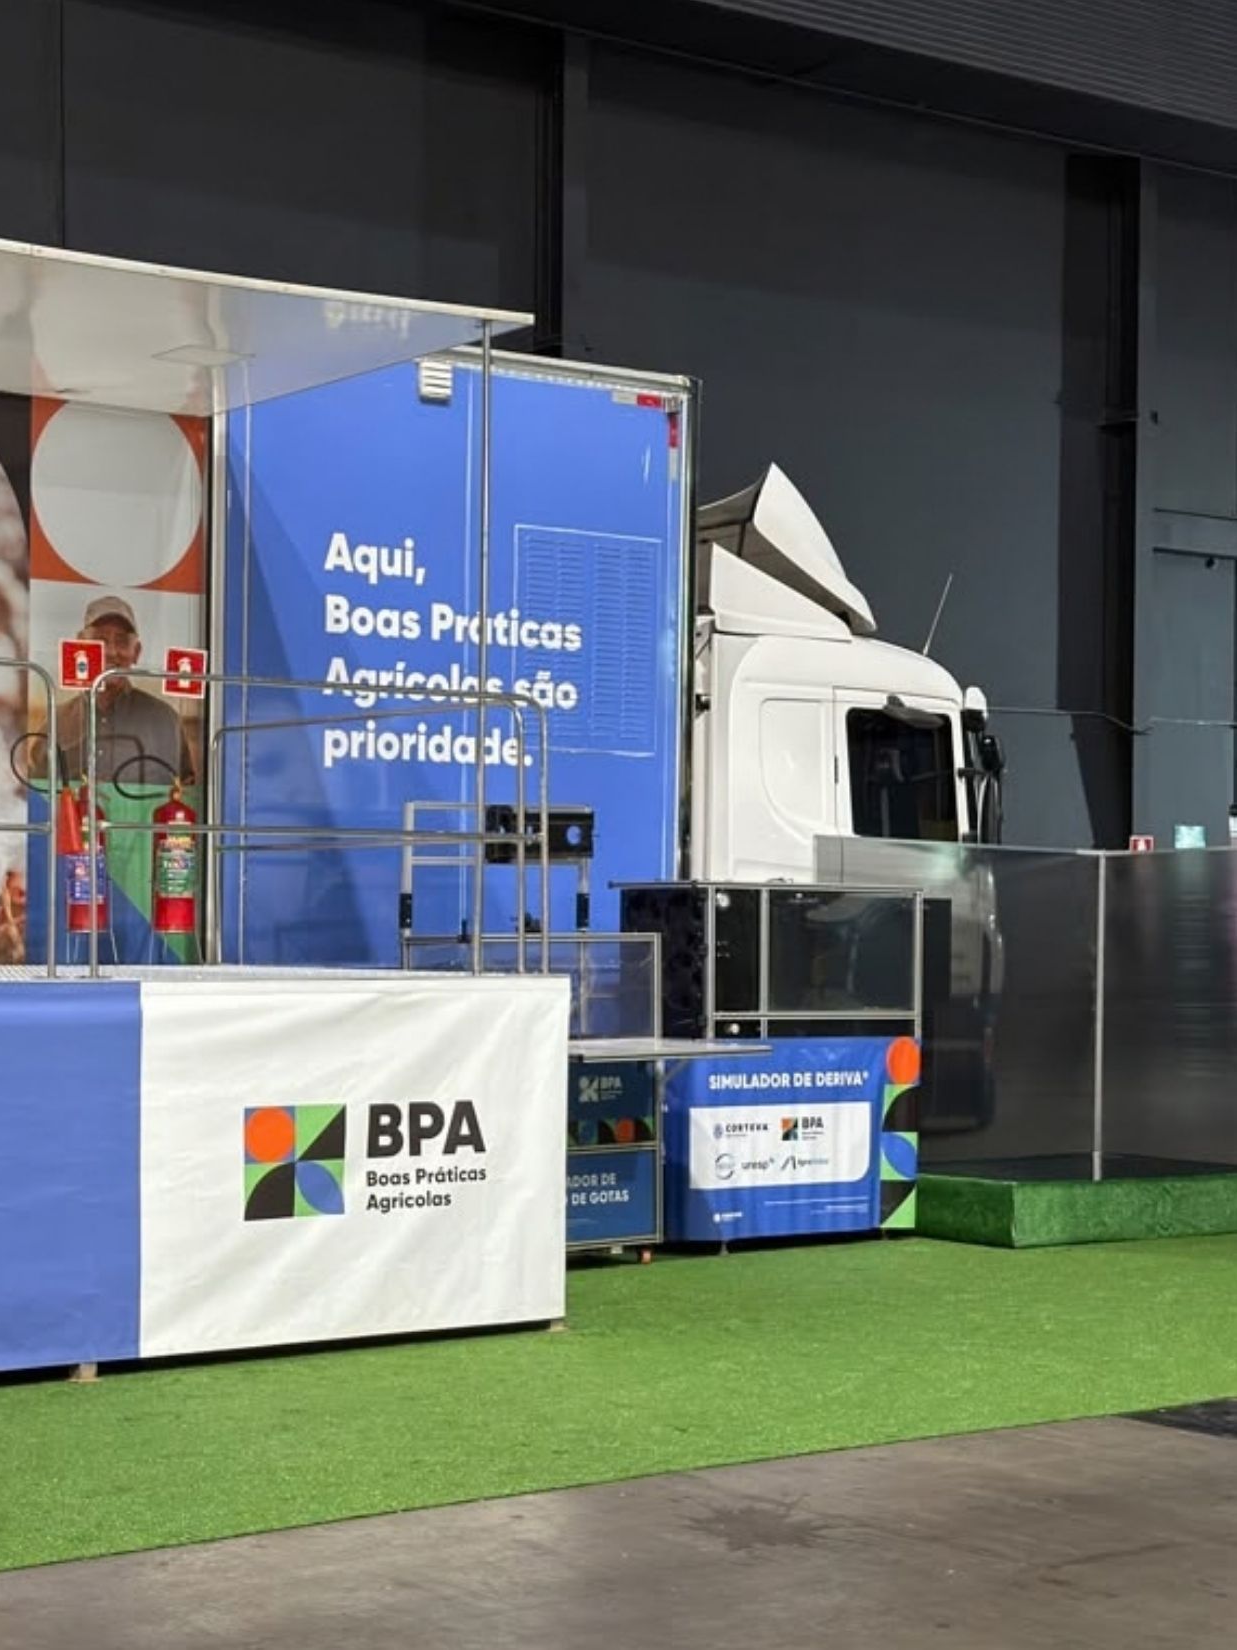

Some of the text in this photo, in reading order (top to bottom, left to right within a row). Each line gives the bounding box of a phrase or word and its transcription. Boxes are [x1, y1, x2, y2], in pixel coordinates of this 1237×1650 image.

[324, 532, 426, 586] Aqui,
[325, 594, 582, 652] Boas Práticas
[514, 670, 578, 710] são
[323, 719, 534, 768] prioridade.
[708, 1072, 790, 1090] SIMULADOR
[793, 1072, 812, 1088] DE
[366, 1099, 486, 1159] BPA
[801, 1116, 824, 1129] BPA
[366, 1166, 487, 1187] Boas Práticas
[571, 1189, 630, 1204] DE GOTAS
